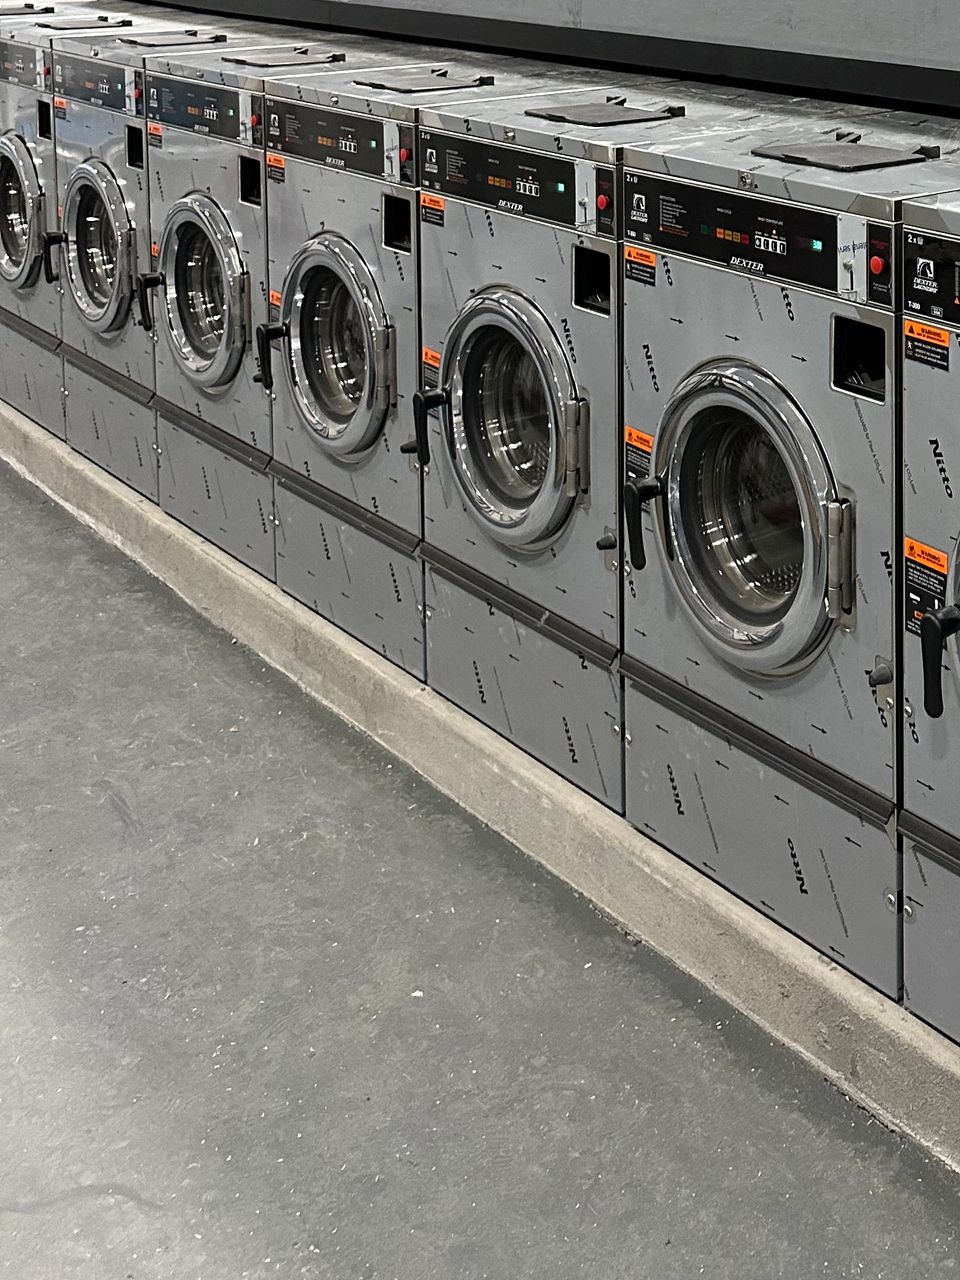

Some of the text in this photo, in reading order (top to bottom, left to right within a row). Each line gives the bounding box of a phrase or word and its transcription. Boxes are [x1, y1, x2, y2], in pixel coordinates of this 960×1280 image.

[498, 200, 524, 211] DEXTER
[730, 256, 764, 271] DEXTER
[913, 277, 938, 288] DEXTER
[929, 438, 953, 499] Nitto
[787, 837, 809, 895] Nitto
